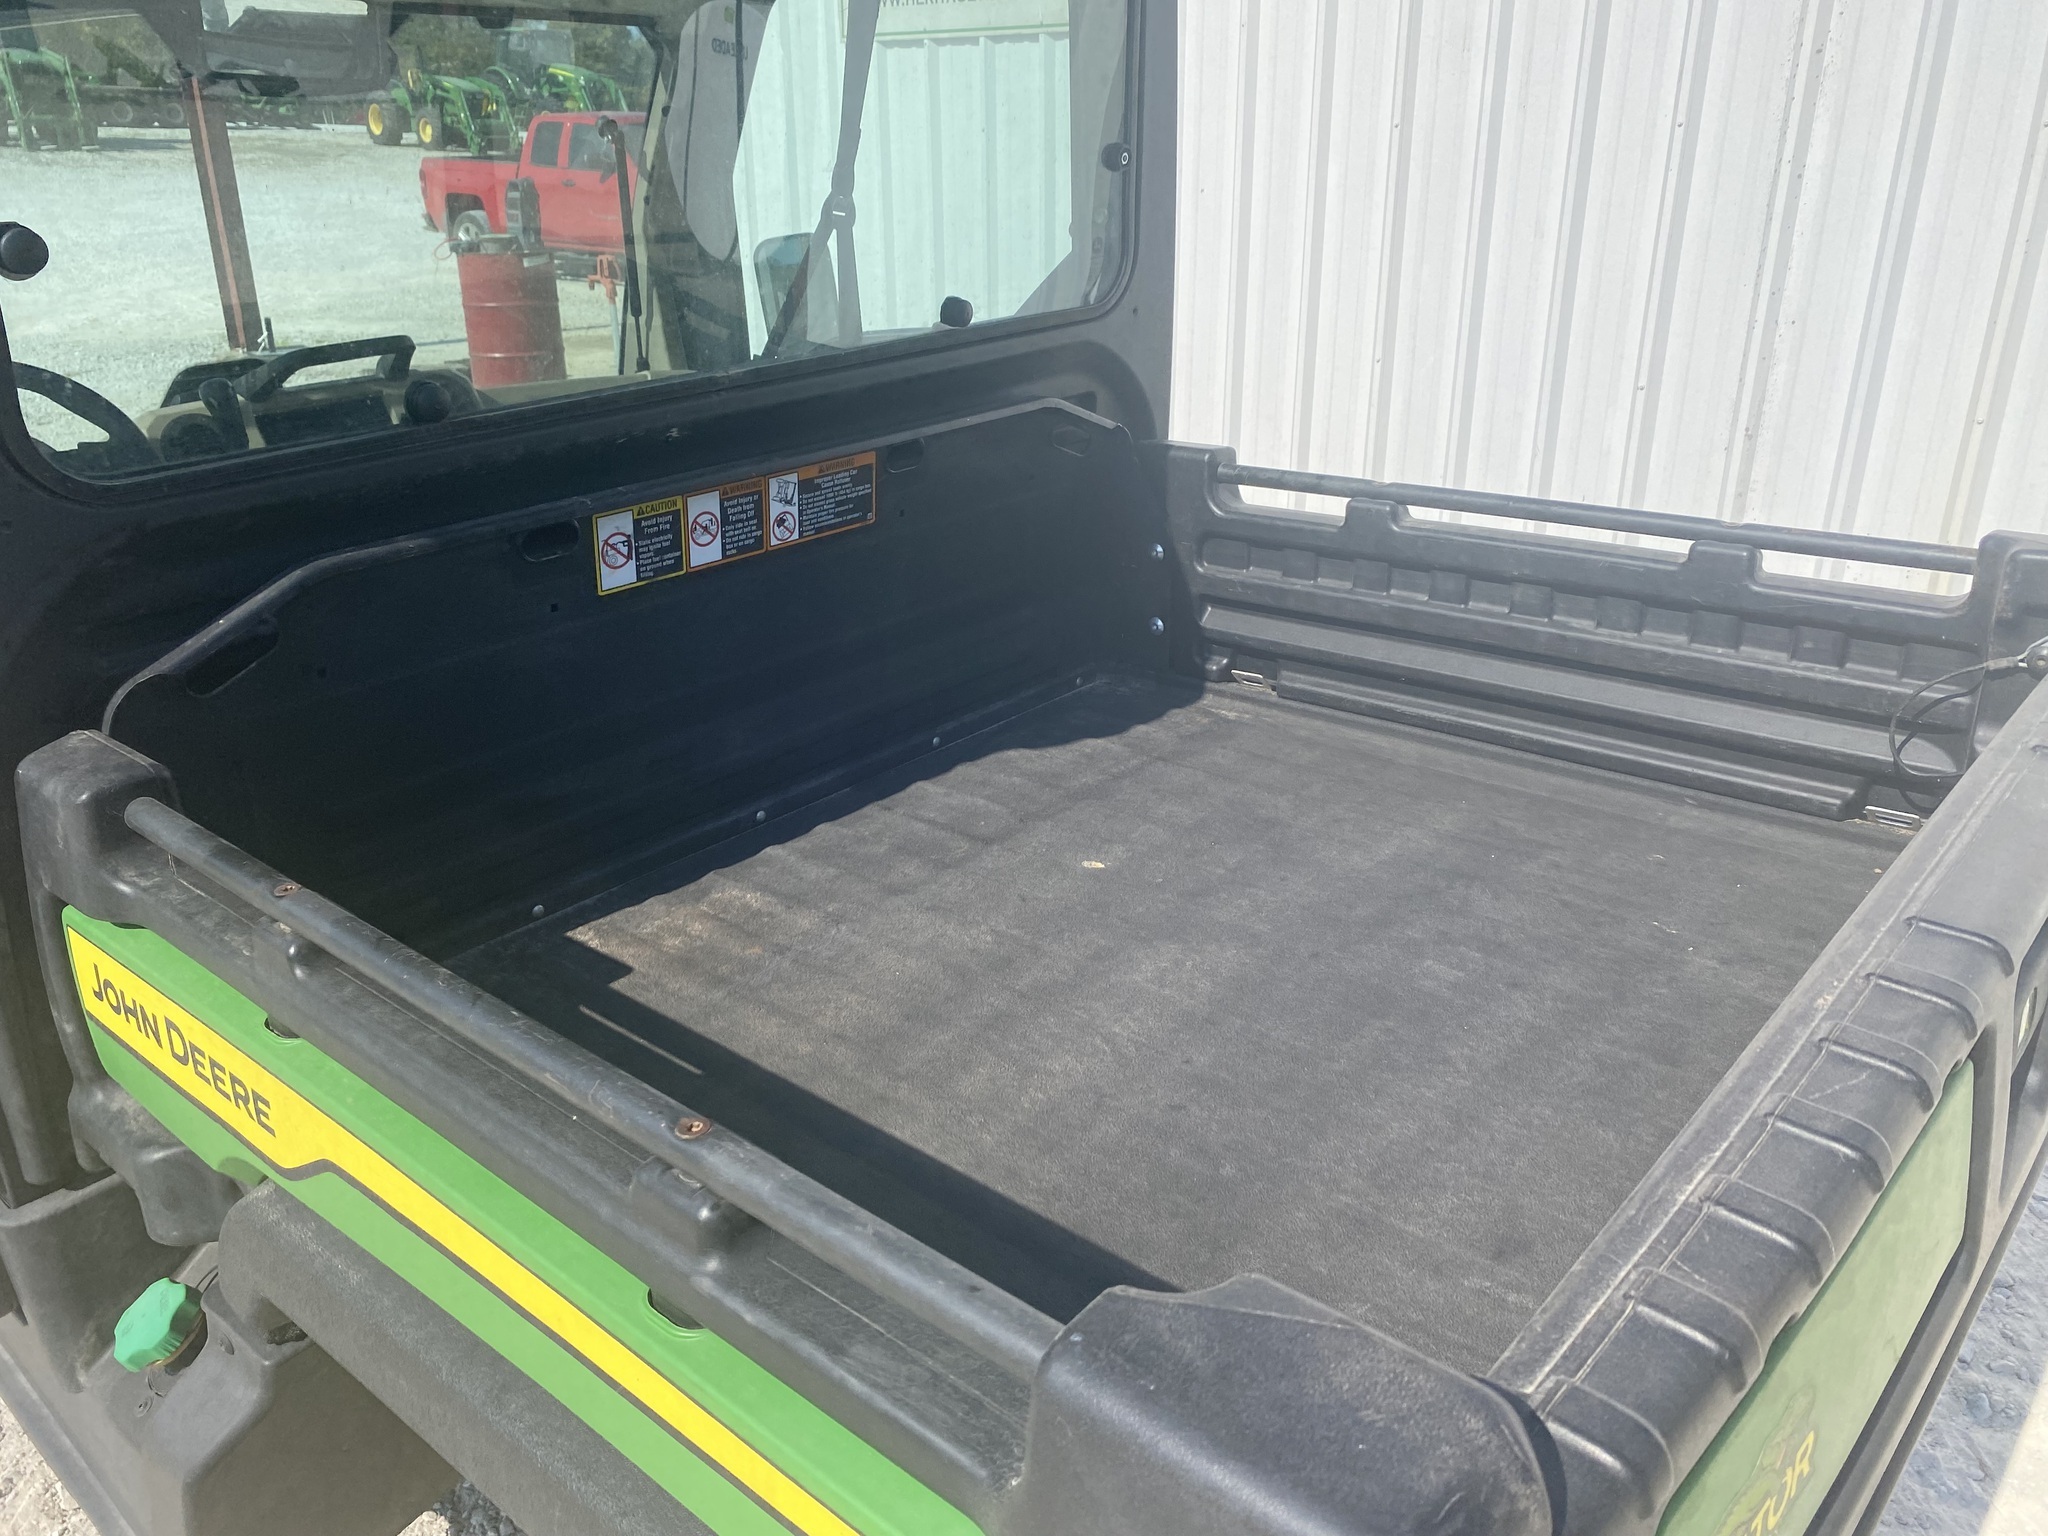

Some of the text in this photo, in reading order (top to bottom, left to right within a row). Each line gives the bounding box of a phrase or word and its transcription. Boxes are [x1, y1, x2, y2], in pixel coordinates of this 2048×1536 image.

[826, 457, 855, 472] WARNING
[730, 480, 762, 494] WARNING
[645, 499, 677, 514] CAUTION
[724, 498, 737, 507] Avoid
[739, 496, 753, 504] Injury
[728, 505, 742, 514] Death
[641, 515, 673, 527] Avoid Injury
[660, 523, 670, 531] Fire
[91, 961, 277, 1138] JOHN DEERE
